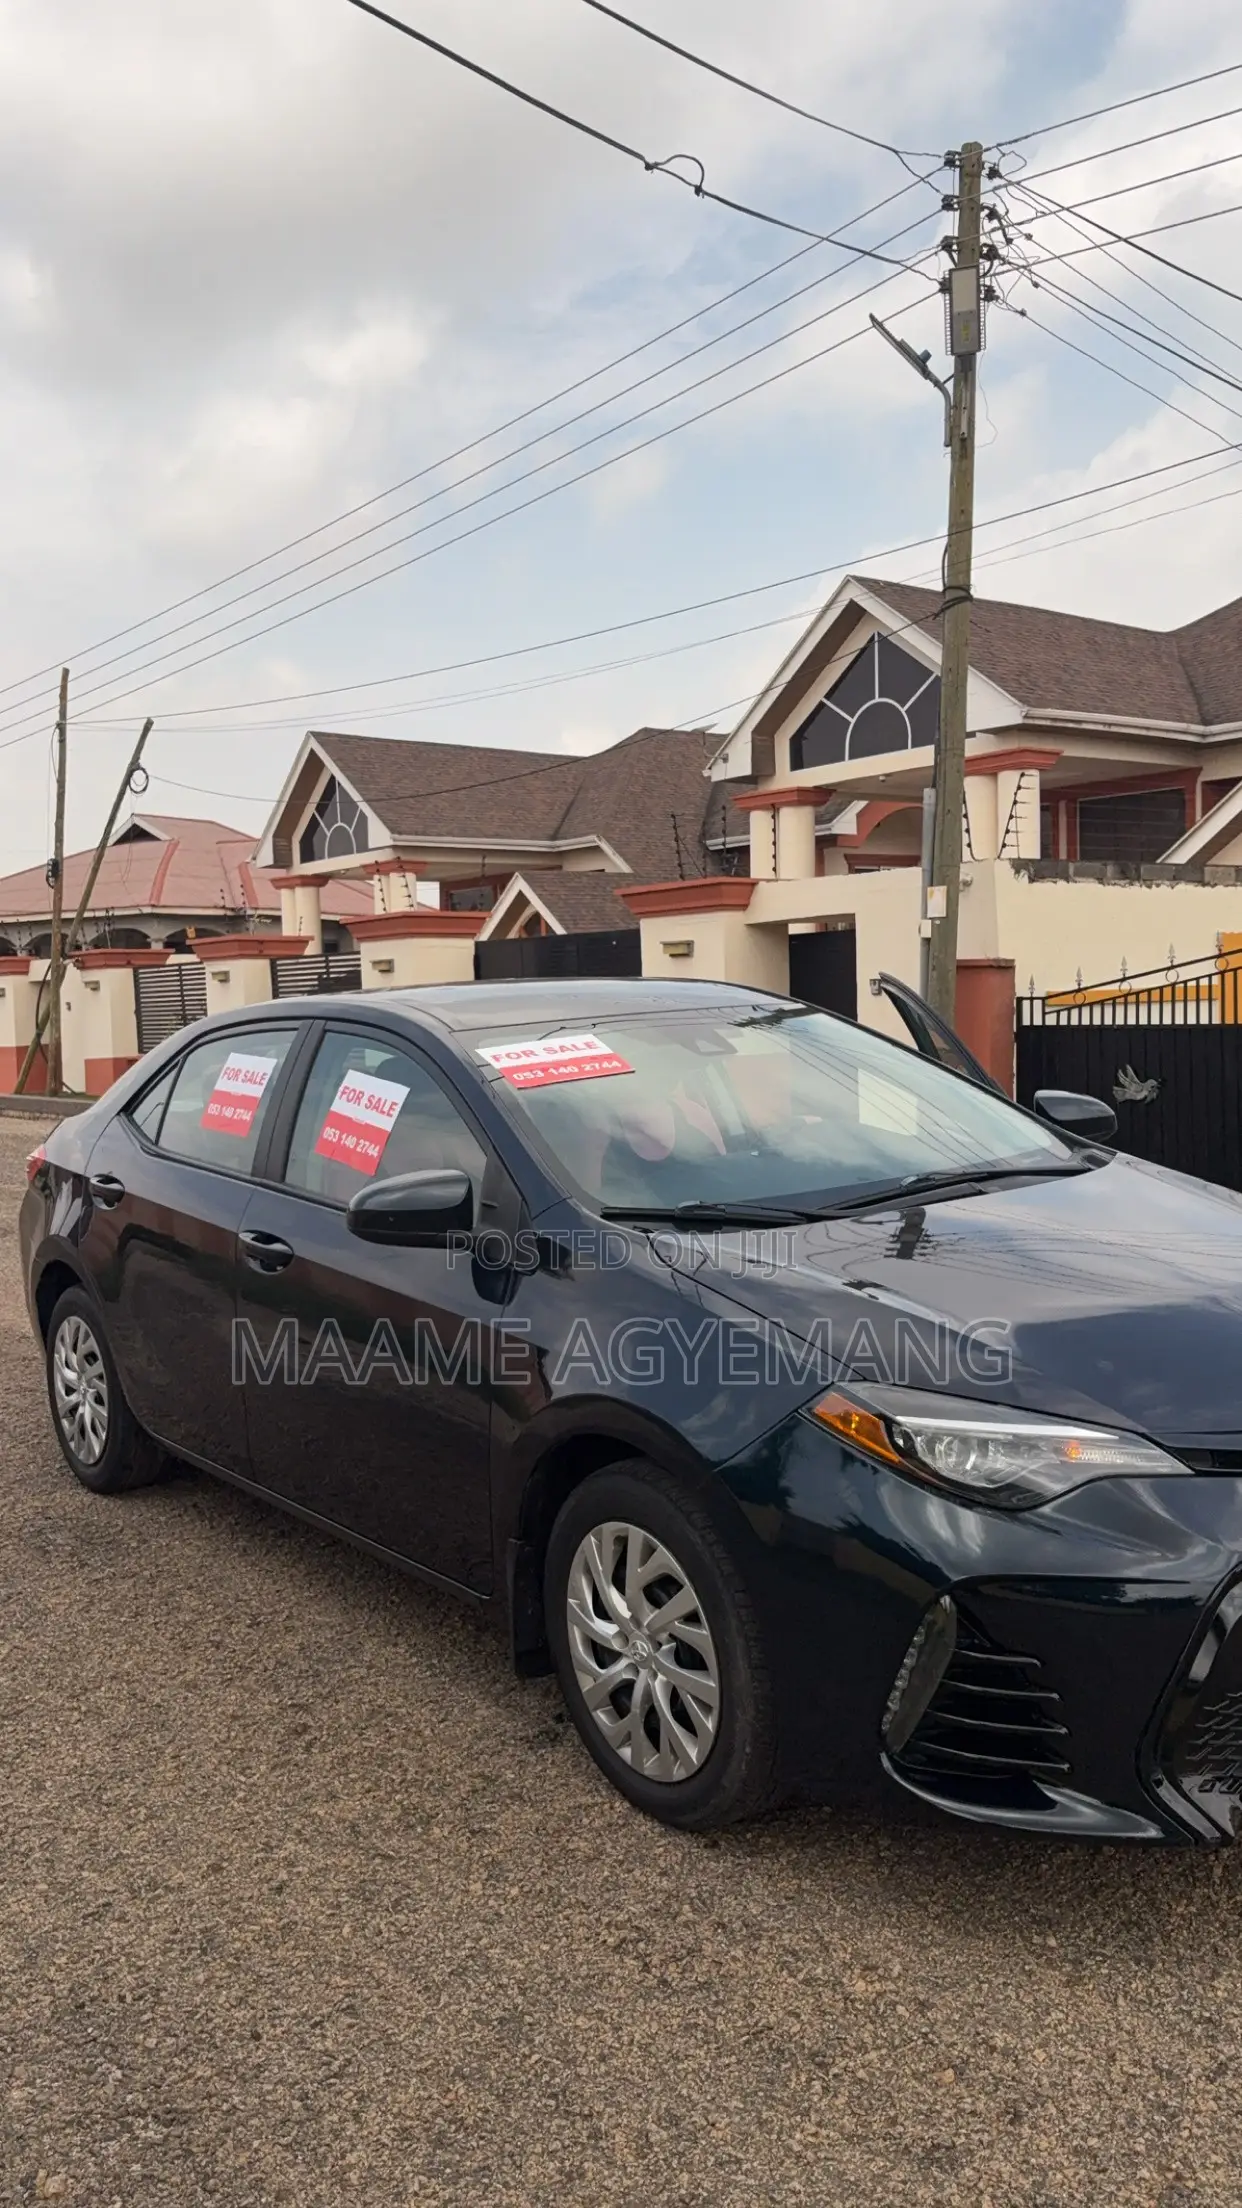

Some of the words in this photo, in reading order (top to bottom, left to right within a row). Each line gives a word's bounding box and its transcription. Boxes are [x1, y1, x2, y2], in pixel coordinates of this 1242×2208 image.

[490, 1048, 539, 1063] FOR
[542, 1040, 601, 1055] SALE
[221, 1066, 242, 1081] FOR
[241, 1070, 268, 1086] SALE
[512, 1069, 545, 1081] 053
[548, 1065, 579, 1076] 140
[581, 1059, 622, 1071] 2744
[340, 1085, 364, 1106] FOR
[365, 1094, 398, 1117] SALE
[323, 1127, 340, 1143] 053
[340, 1133, 356, 1149] 140
[356, 1139, 380, 1158] 2744
